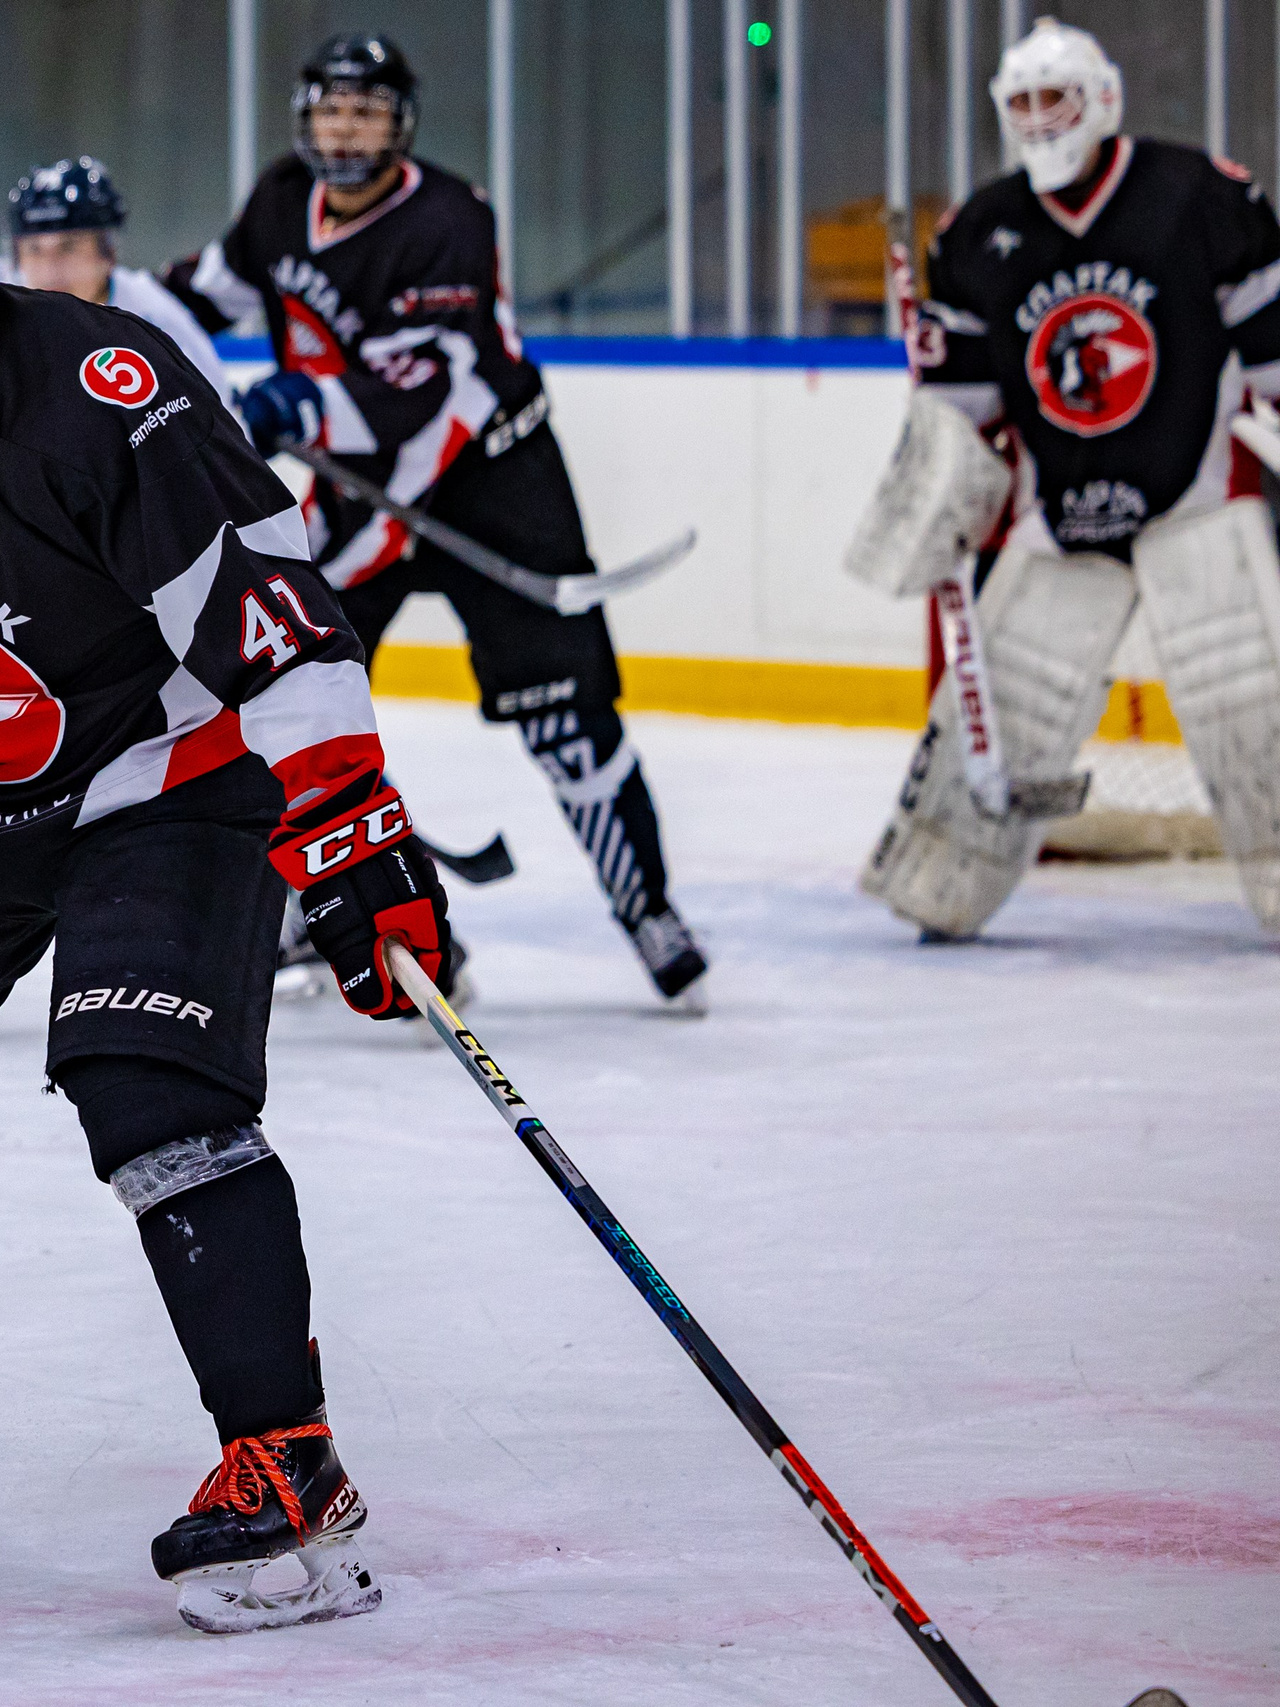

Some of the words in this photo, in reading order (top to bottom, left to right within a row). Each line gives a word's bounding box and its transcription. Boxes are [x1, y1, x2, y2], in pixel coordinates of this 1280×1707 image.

[301, 797, 412, 876] CC
[55, 987, 214, 1029] BAUER
[342, 967, 371, 992] CCM
[454, 1029, 527, 1107] CCM
[603, 1220, 682, 1310] JETSPEED
